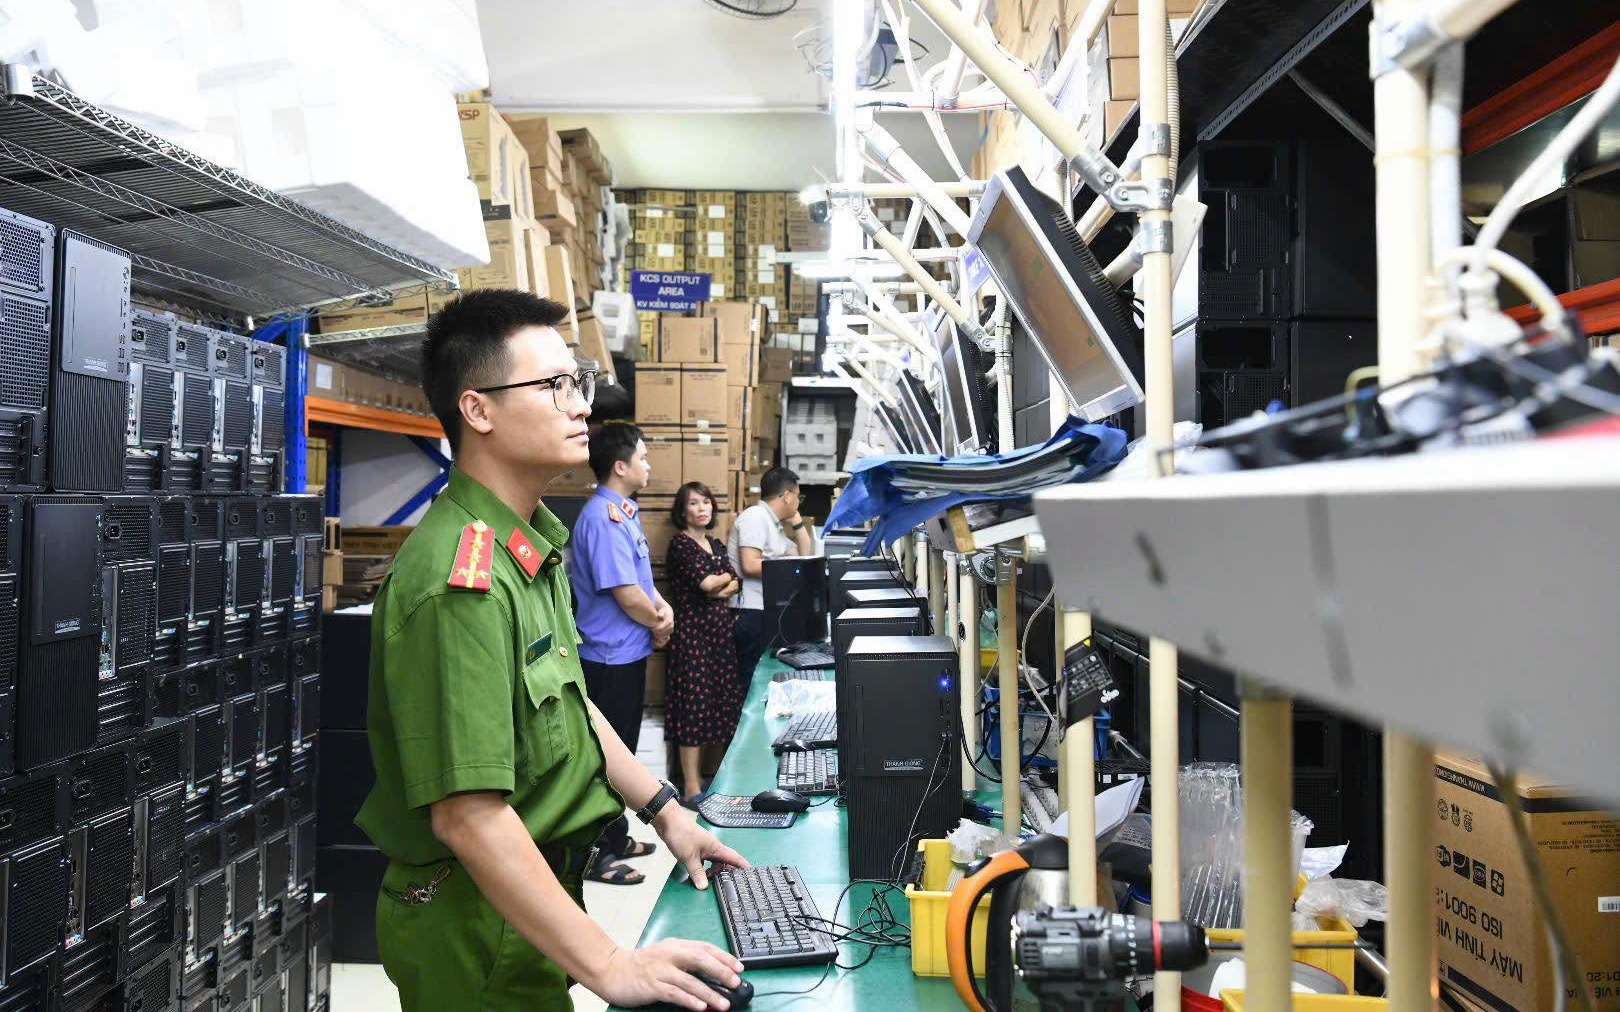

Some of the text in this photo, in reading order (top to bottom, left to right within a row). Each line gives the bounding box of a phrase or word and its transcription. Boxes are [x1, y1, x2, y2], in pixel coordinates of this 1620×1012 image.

[640, 274, 701, 284] KCS OUTPUT
[658, 286, 685, 296] AREA
[636, 300, 648, 308] KV
[1435, 887, 1504, 940] ISO 9001:
[1455, 927, 1487, 962] TÍNH
[1490, 948, 1523, 984] MÁY
